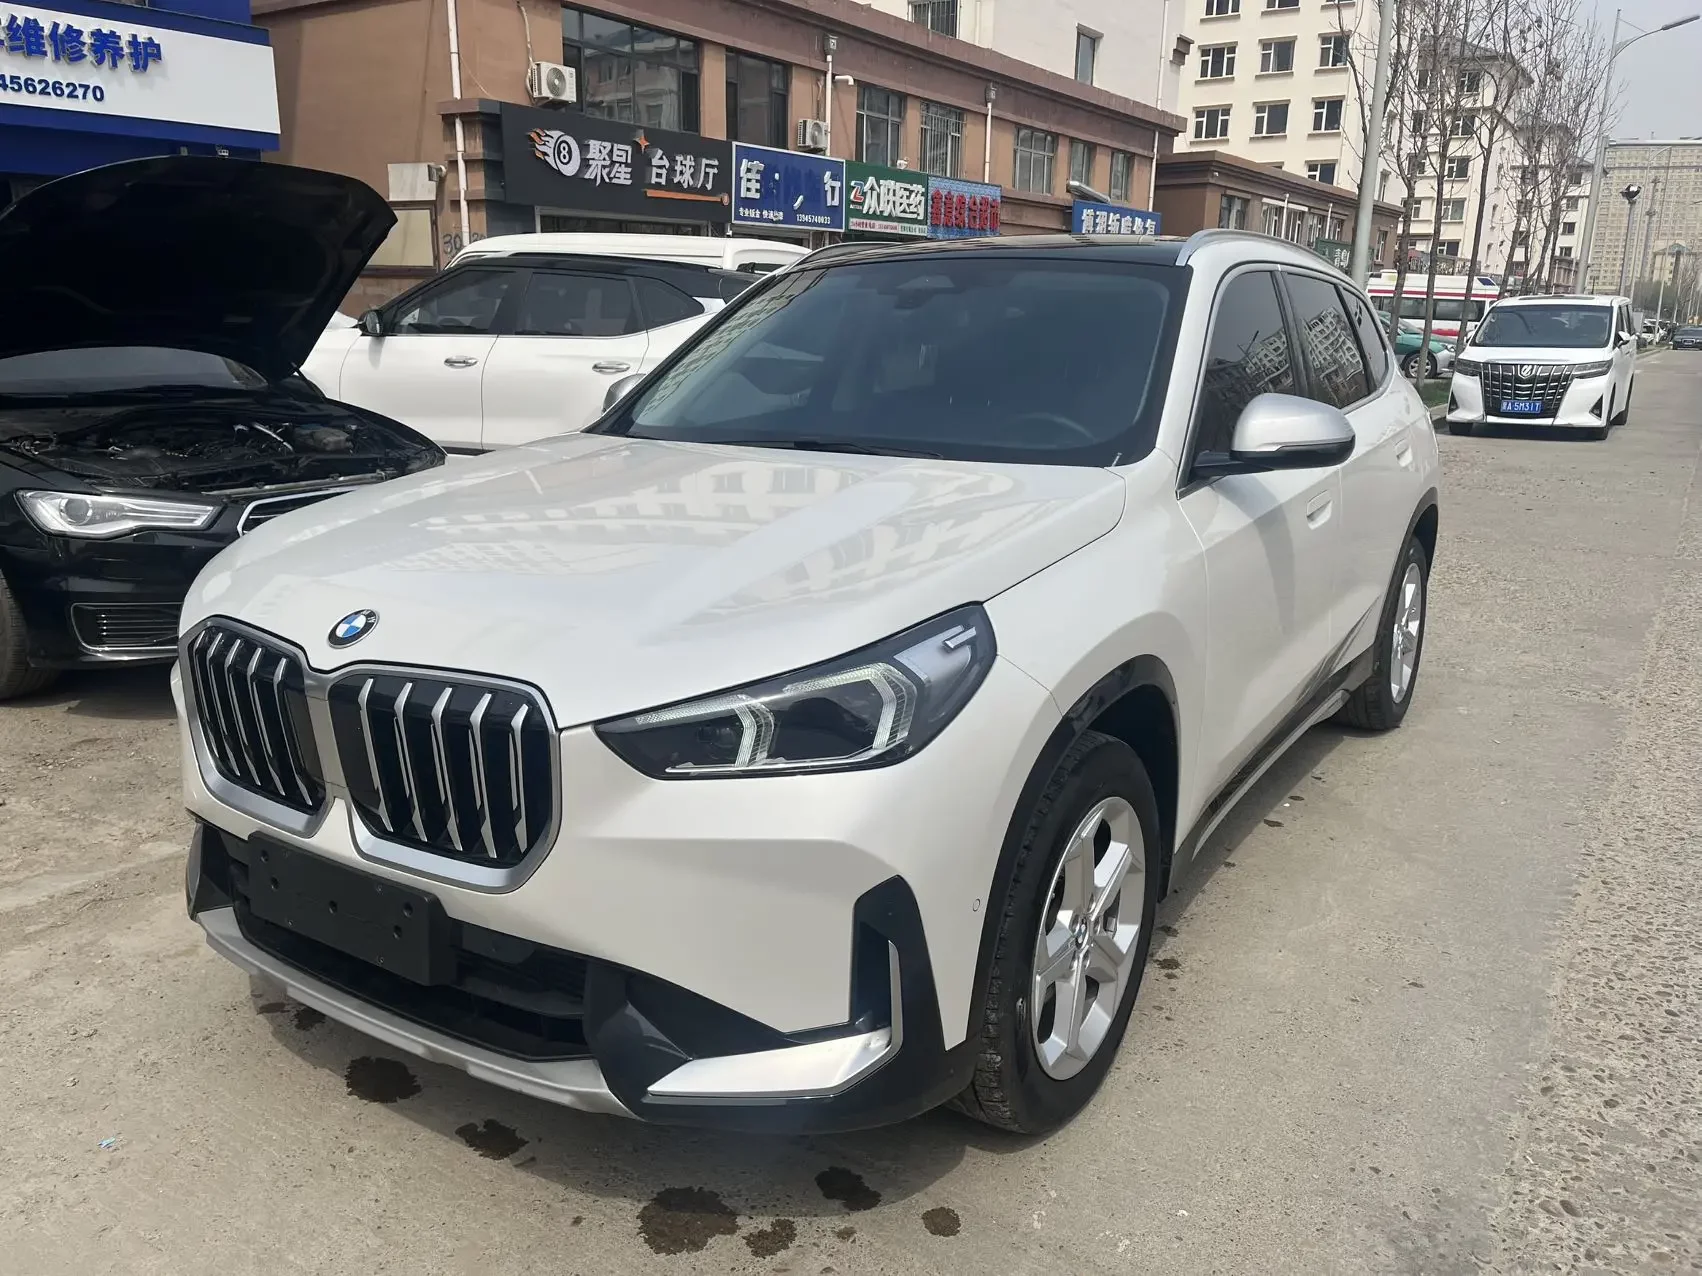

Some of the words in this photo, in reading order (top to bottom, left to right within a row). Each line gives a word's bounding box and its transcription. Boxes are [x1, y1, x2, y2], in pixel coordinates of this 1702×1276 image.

[0, 13, 162, 72] 维修养护
[650, 149, 719, 191] 台球厅
[862, 176, 925, 220] 众联医药
